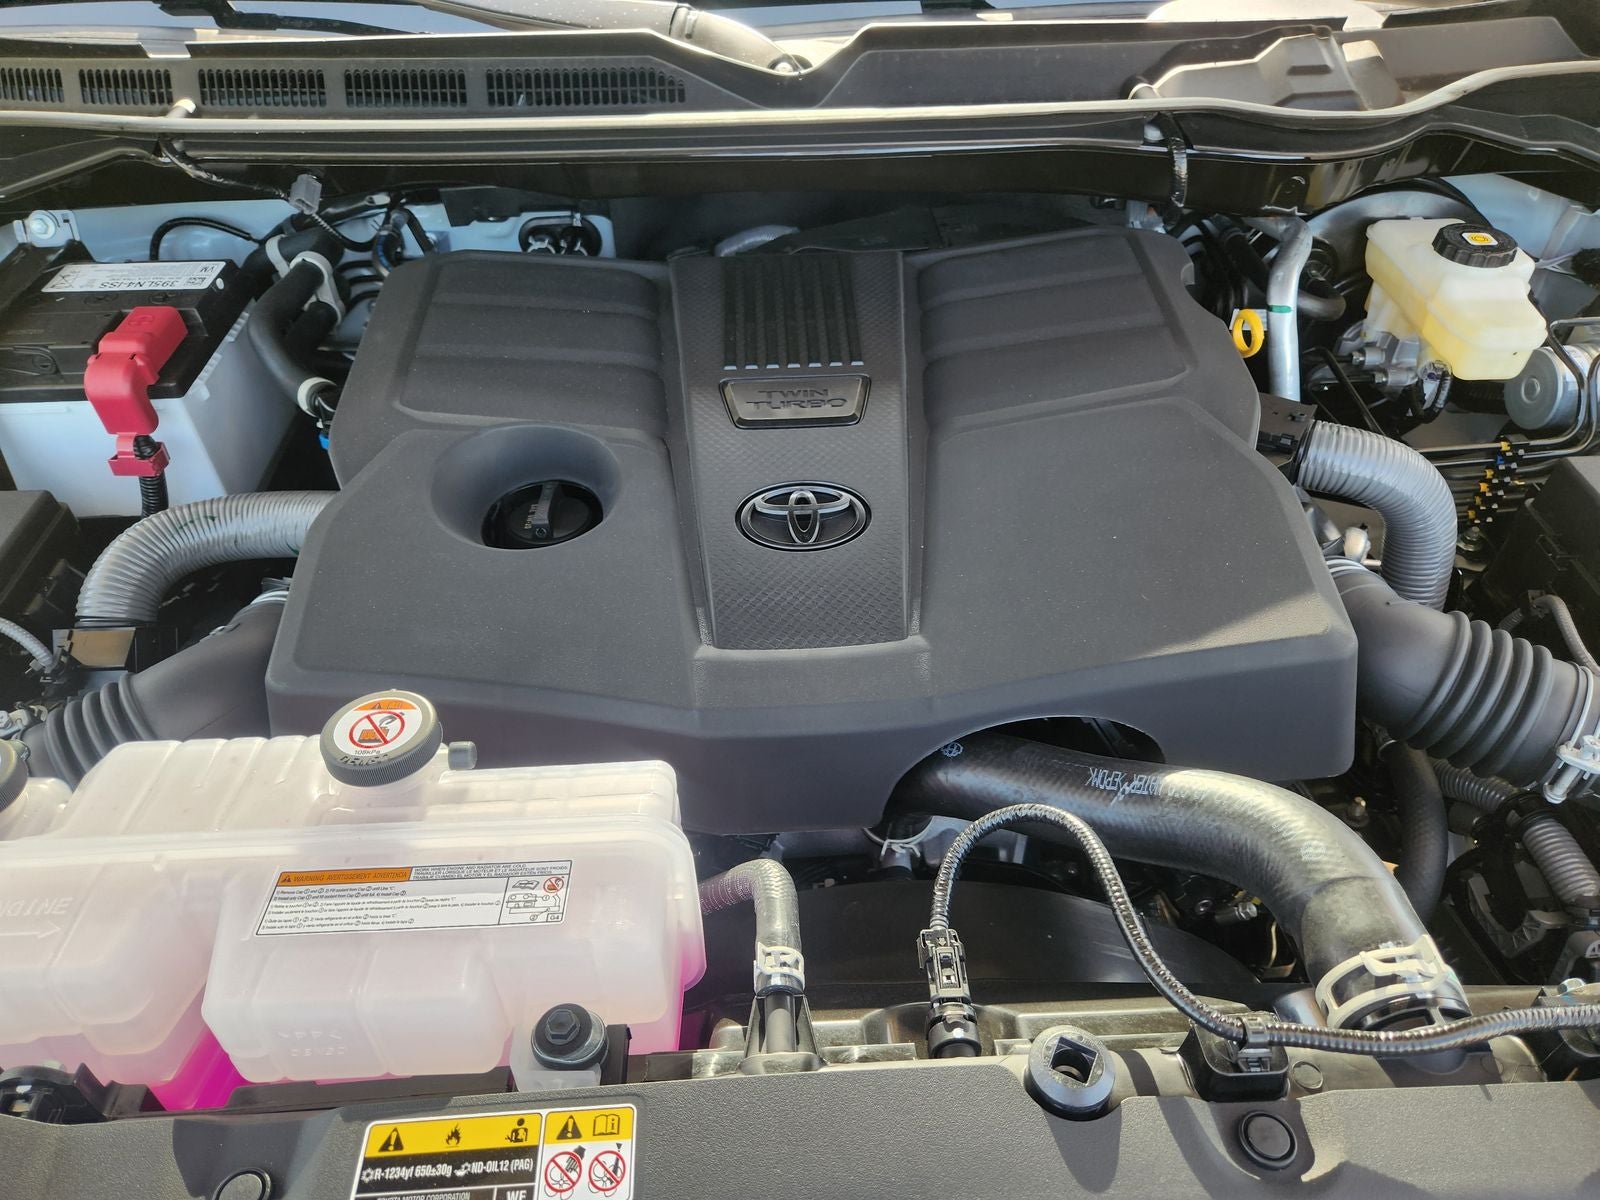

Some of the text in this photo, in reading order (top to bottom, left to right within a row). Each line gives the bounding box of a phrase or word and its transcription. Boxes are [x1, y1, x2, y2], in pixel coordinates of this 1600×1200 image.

[757, 388, 829, 398] TWIN
[745, 397, 848, 410] TURBO
[293, 874, 325, 882] WARNING
[372, 1165, 414, 1181] R-1234yf
[414, 1163, 453, 1178] 650±30g
[510, 1157, 534, 1172] (PAG)
